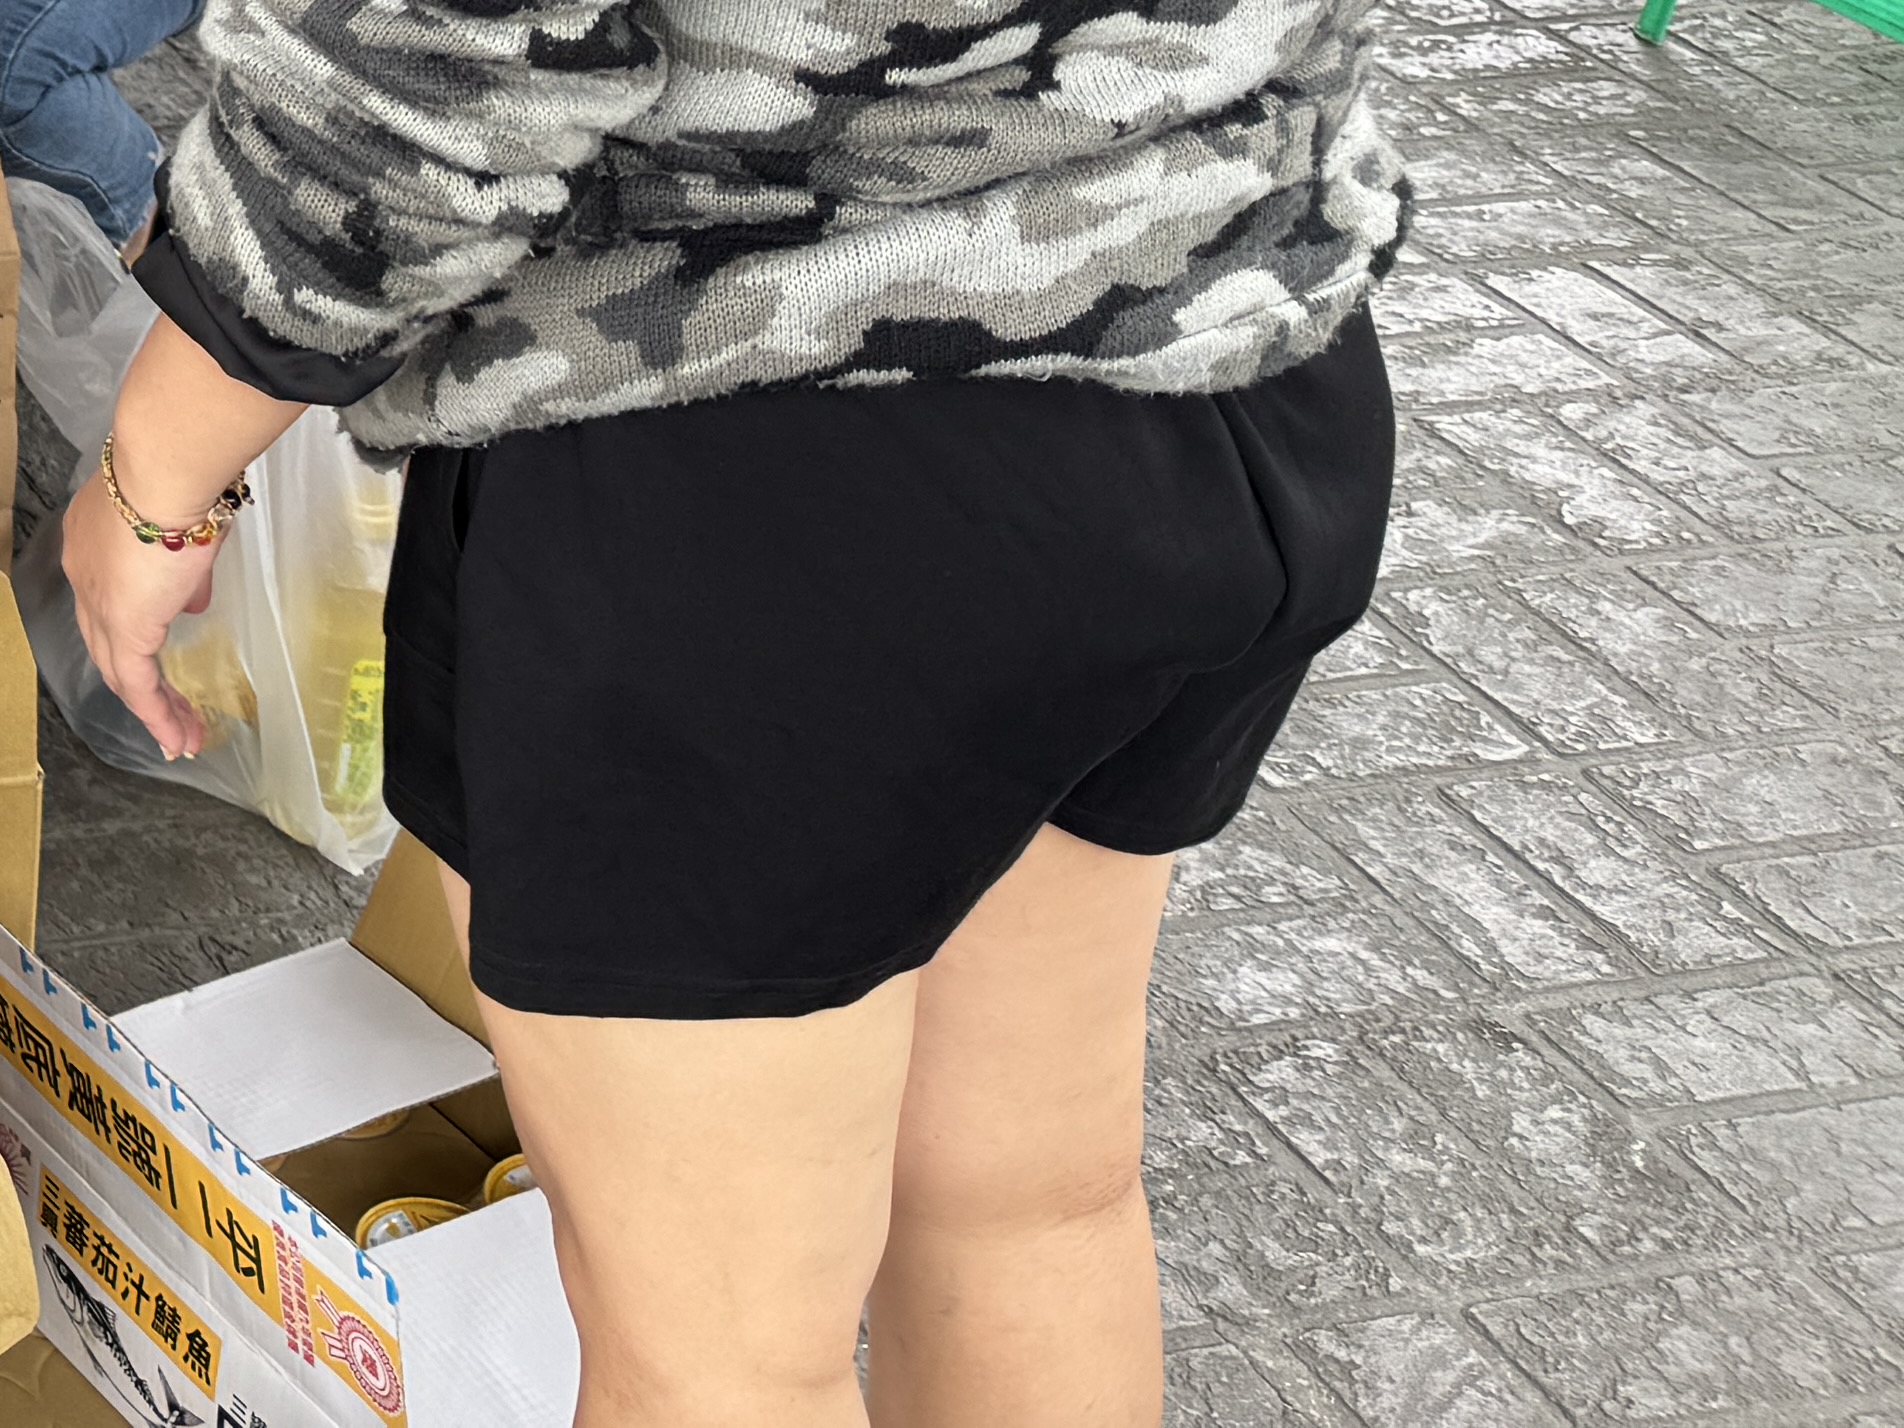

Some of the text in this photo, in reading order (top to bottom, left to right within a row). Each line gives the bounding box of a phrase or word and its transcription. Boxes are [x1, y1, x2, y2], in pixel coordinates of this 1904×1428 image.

[63, 1201, 212, 1386] 蕃茄汁鯖魚
